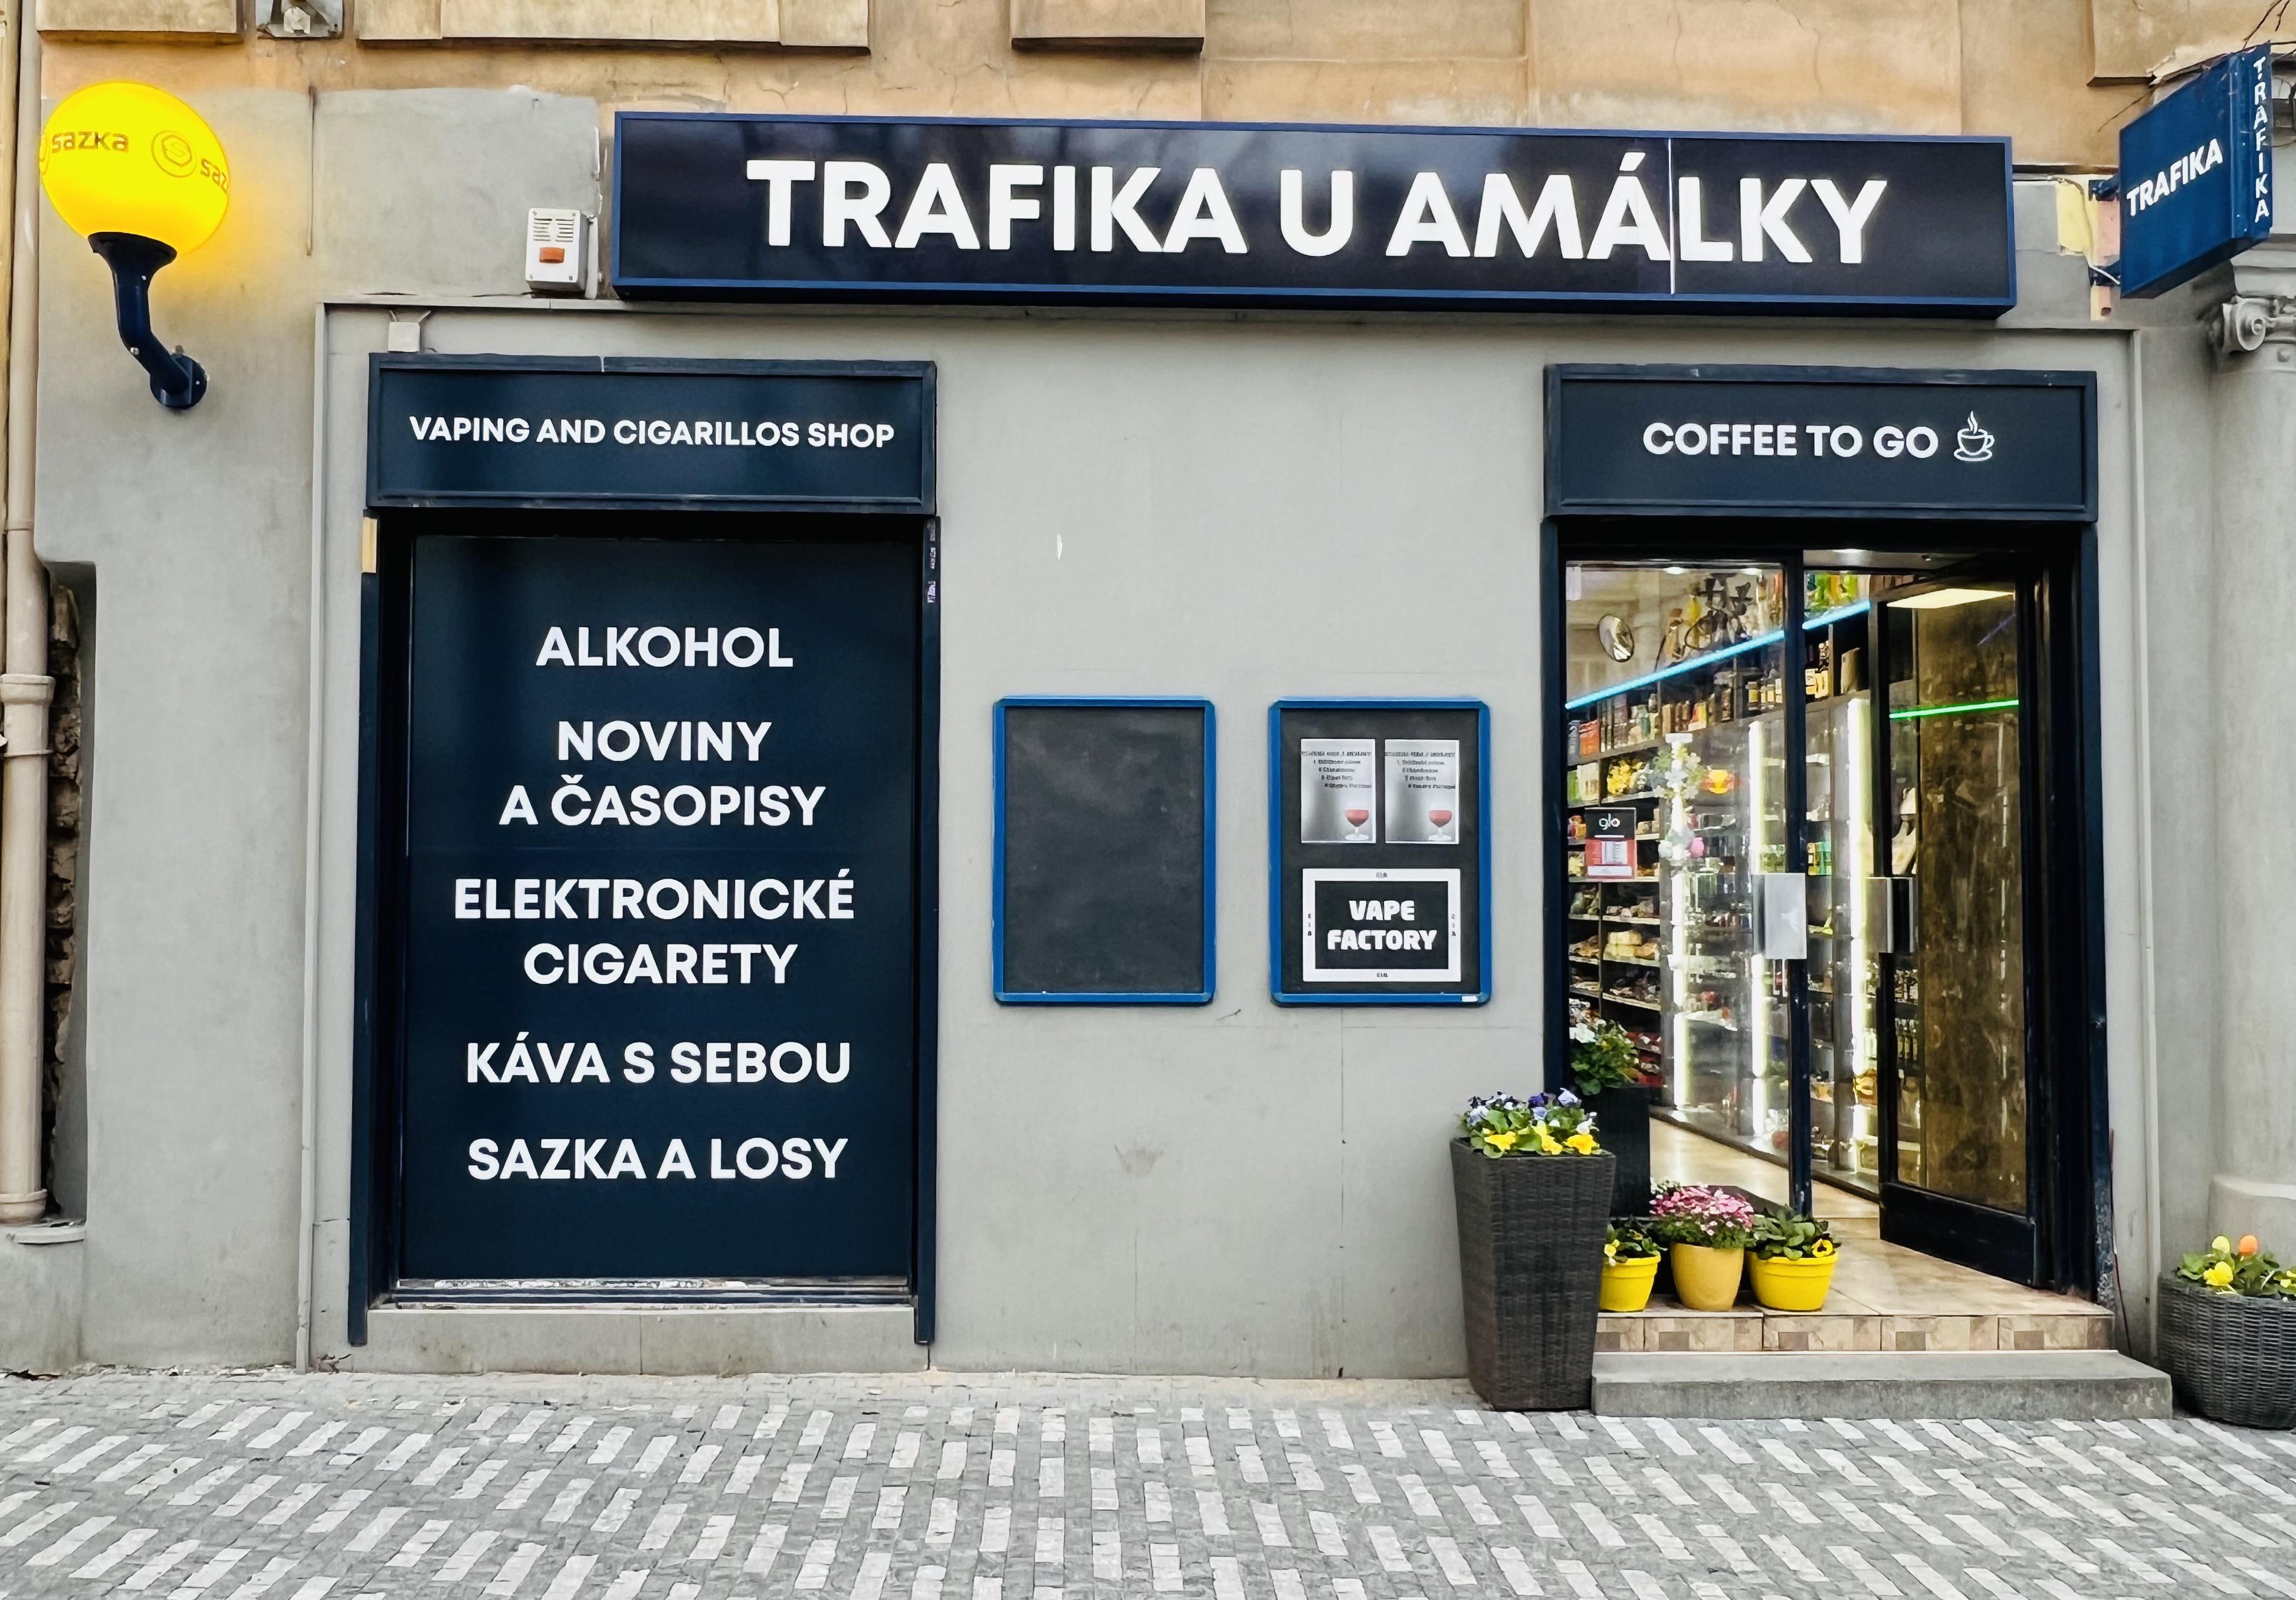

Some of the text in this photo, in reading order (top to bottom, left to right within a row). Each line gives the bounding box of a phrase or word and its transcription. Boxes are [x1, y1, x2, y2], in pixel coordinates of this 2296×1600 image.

[52, 131, 129, 153] sazka
[2254, 56, 2269, 224] TRAFIKA
[2126, 138, 2223, 217] TRAFIKA
[747, 151, 1887, 264] TRAFIKA U AMÁLKY
[409, 416, 894, 448] VAPING AND CIGARILLOS SHOP
[1643, 422, 1939, 458] COFFEE TO GO
[535, 626, 793, 668] ALKOHOL
[558, 720, 772, 762] NOVINY
[498, 773, 826, 827] A ČASOPISY
[1599, 813, 1621, 830] glo
[455, 869, 854, 920] ELEKTRONICKÉ
[1349, 900, 1415, 921] VAPE
[1327, 929, 1438, 950] FACTORY
[524, 943, 798, 985] CIGARETY
[467, 1031, 850, 1084] KÁVA S SEBOU
[468, 1137, 848, 1180] SAZKA A LOSY
